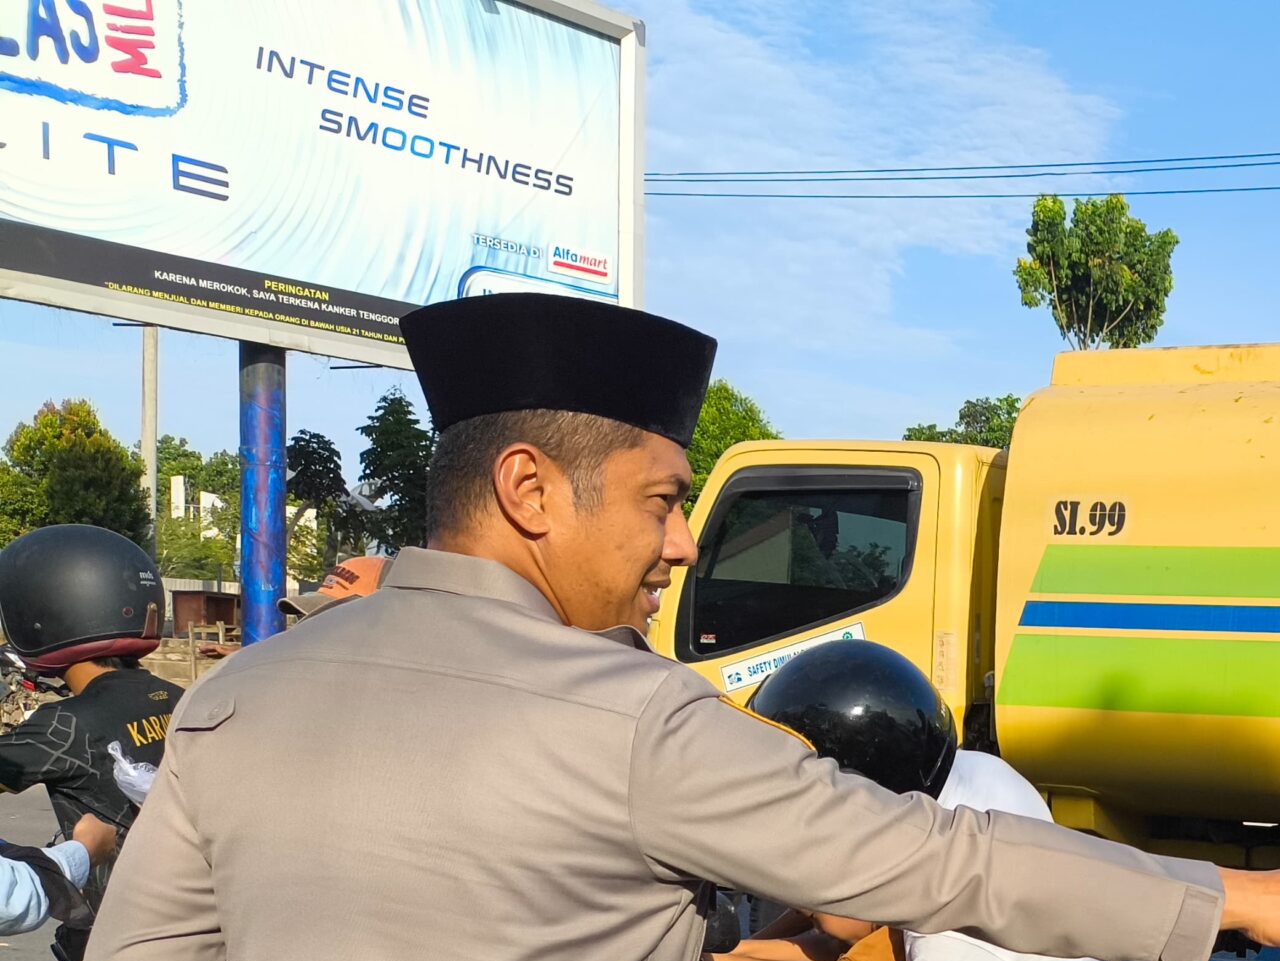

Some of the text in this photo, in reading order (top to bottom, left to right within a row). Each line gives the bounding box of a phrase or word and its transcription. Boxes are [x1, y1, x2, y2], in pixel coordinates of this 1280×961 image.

[256, 46, 431, 119] INTENSE
[319, 108, 575, 197] SMOOTHNESS
[472, 233, 528, 256] TERSEDIA
[553, 246, 608, 270] Alfamart
[154, 269, 198, 287] KARENA
[199, 279, 251, 298] MEROKOK,
[252, 289, 277, 302] SAYA
[277, 294, 320, 310] TERKENA
[321, 303, 358, 317] KANKER
[264, 279, 330, 301] PERINGATAN
[151, 290, 189, 304] MENJUAL
[190, 298, 207, 307] DAN
[208, 301, 244, 314] MEMBERI
[245, 308, 274, 319] KEPADA
[274, 314, 301, 325] ORANG
[301, 318, 309, 326] DI
[310, 320, 335, 331] BAWAH
[335, 325, 352, 334] USIA
[352, 328, 360, 336] 21
[361, 329, 383, 340] TAHUN
[383, 333, 398, 343] DAN
[747, 659, 772, 677] SAFETY
